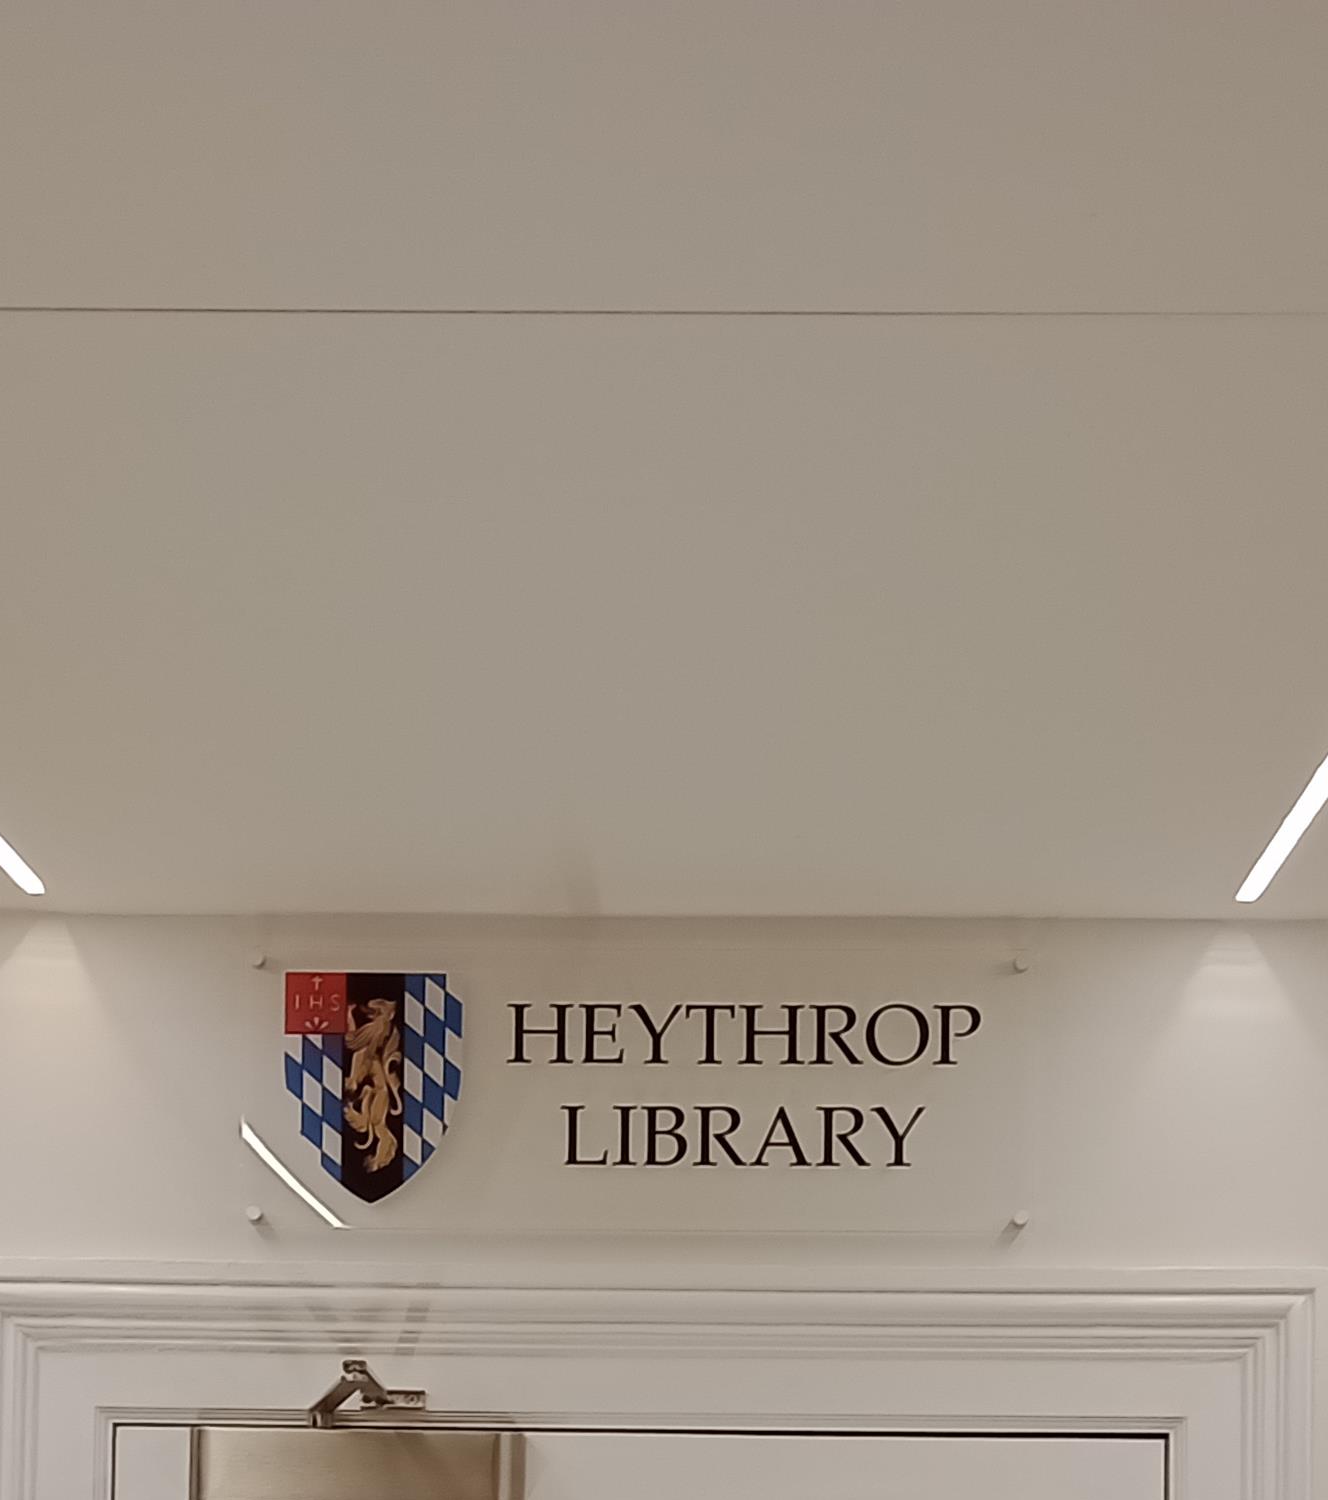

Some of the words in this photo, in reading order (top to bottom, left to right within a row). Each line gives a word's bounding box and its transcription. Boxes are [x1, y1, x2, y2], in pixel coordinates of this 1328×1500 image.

[294, 994, 342, 1012] IHS
[506, 1003, 982, 1066] HEYTHROP
[560, 1104, 926, 1168] LIBRARY
